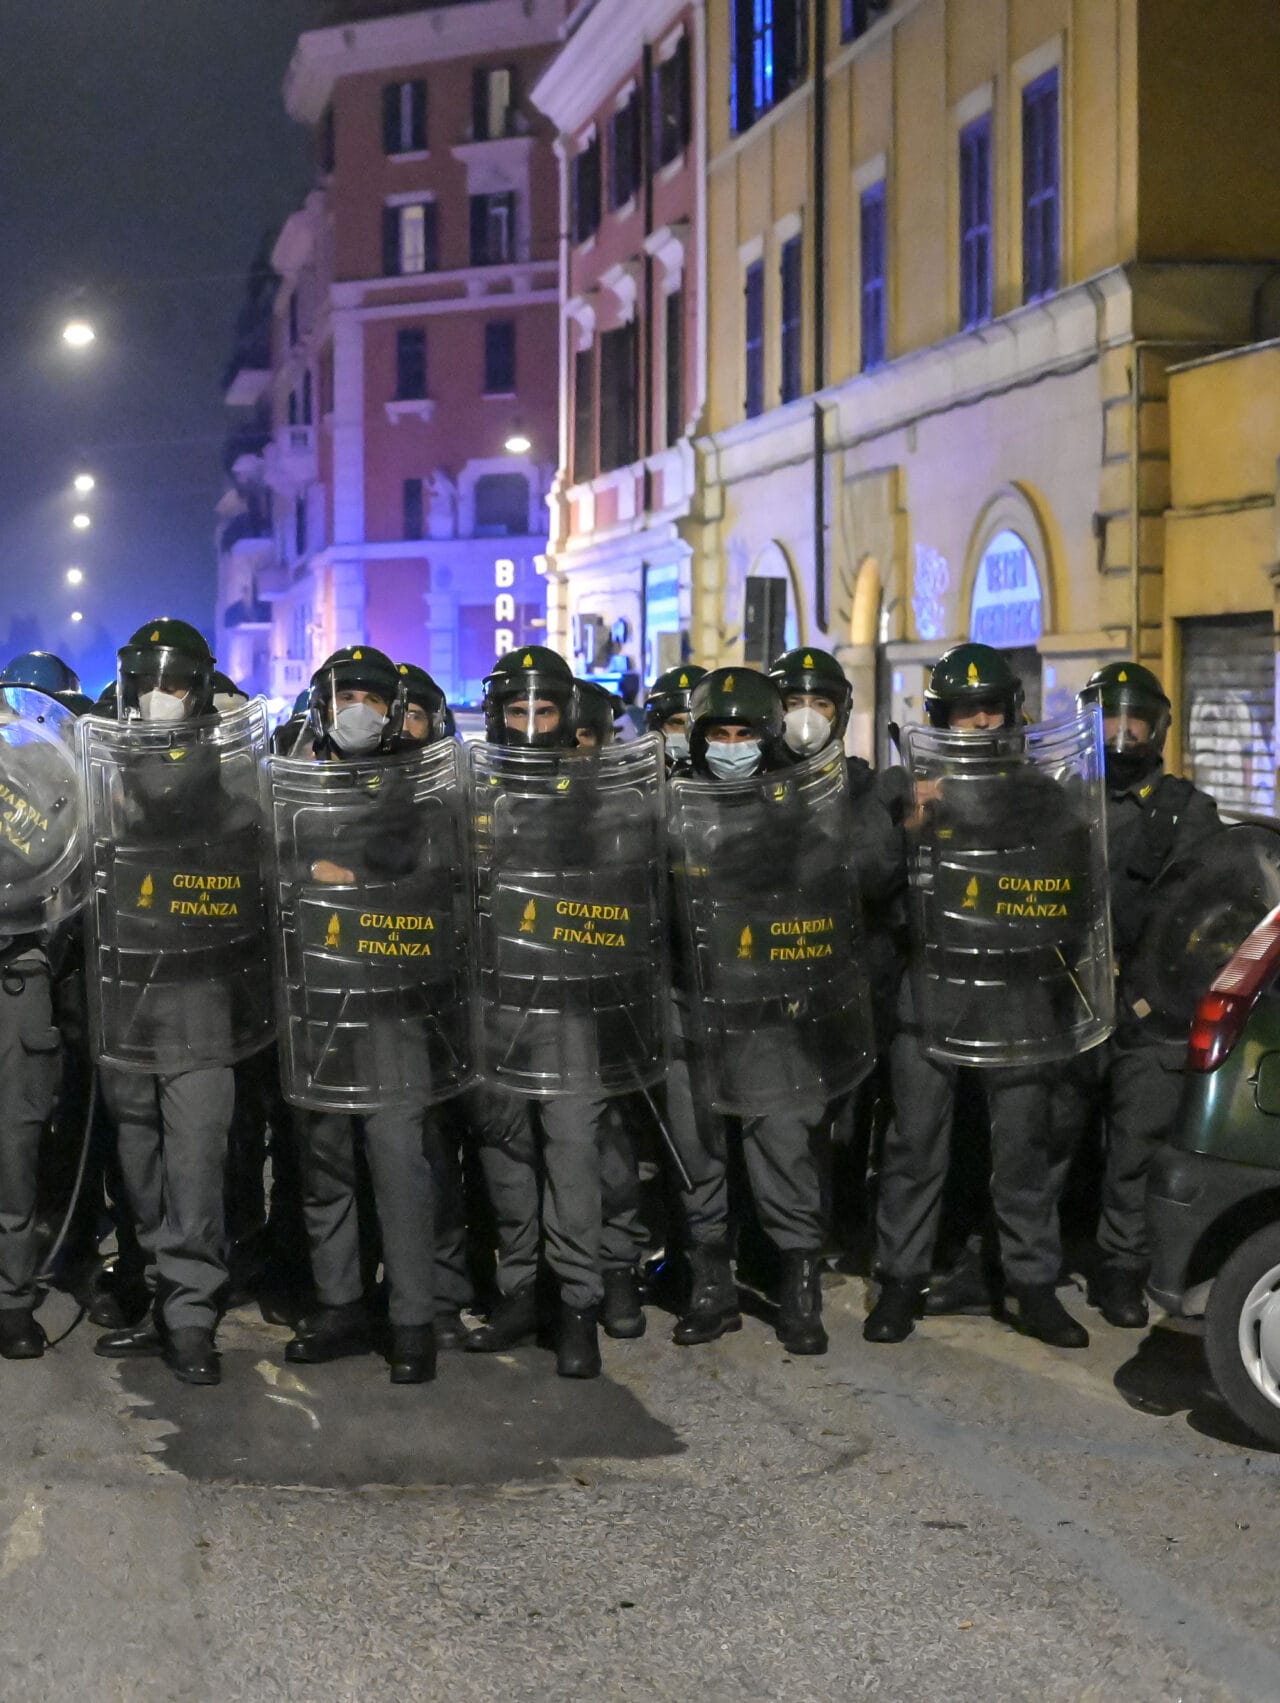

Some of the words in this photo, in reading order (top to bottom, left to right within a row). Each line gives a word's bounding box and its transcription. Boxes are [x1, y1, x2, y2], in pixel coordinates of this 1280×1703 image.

[495, 559, 514, 657] BAR
[3, 811, 19, 826] d
[173, 874, 241, 890] GUARDIA
[999, 876, 1071, 893] GUARDIA
[200, 892, 210, 901] di
[1026, 894, 1037, 904] di
[170, 900, 238, 916] FINANZA
[556, 901, 630, 921] GUARDIA
[996, 903, 1068, 917] FINANZA
[360, 913, 435, 931] GUARDIA
[584, 921, 595, 931] di
[770, 917, 834, 936] GUARDIA
[388, 931, 399, 942] di
[553, 927, 626, 947] FINANZA
[796, 936, 807, 946] di
[358, 940, 431, 956] FINANZA
[769, 943, 833, 961] FINANZA
